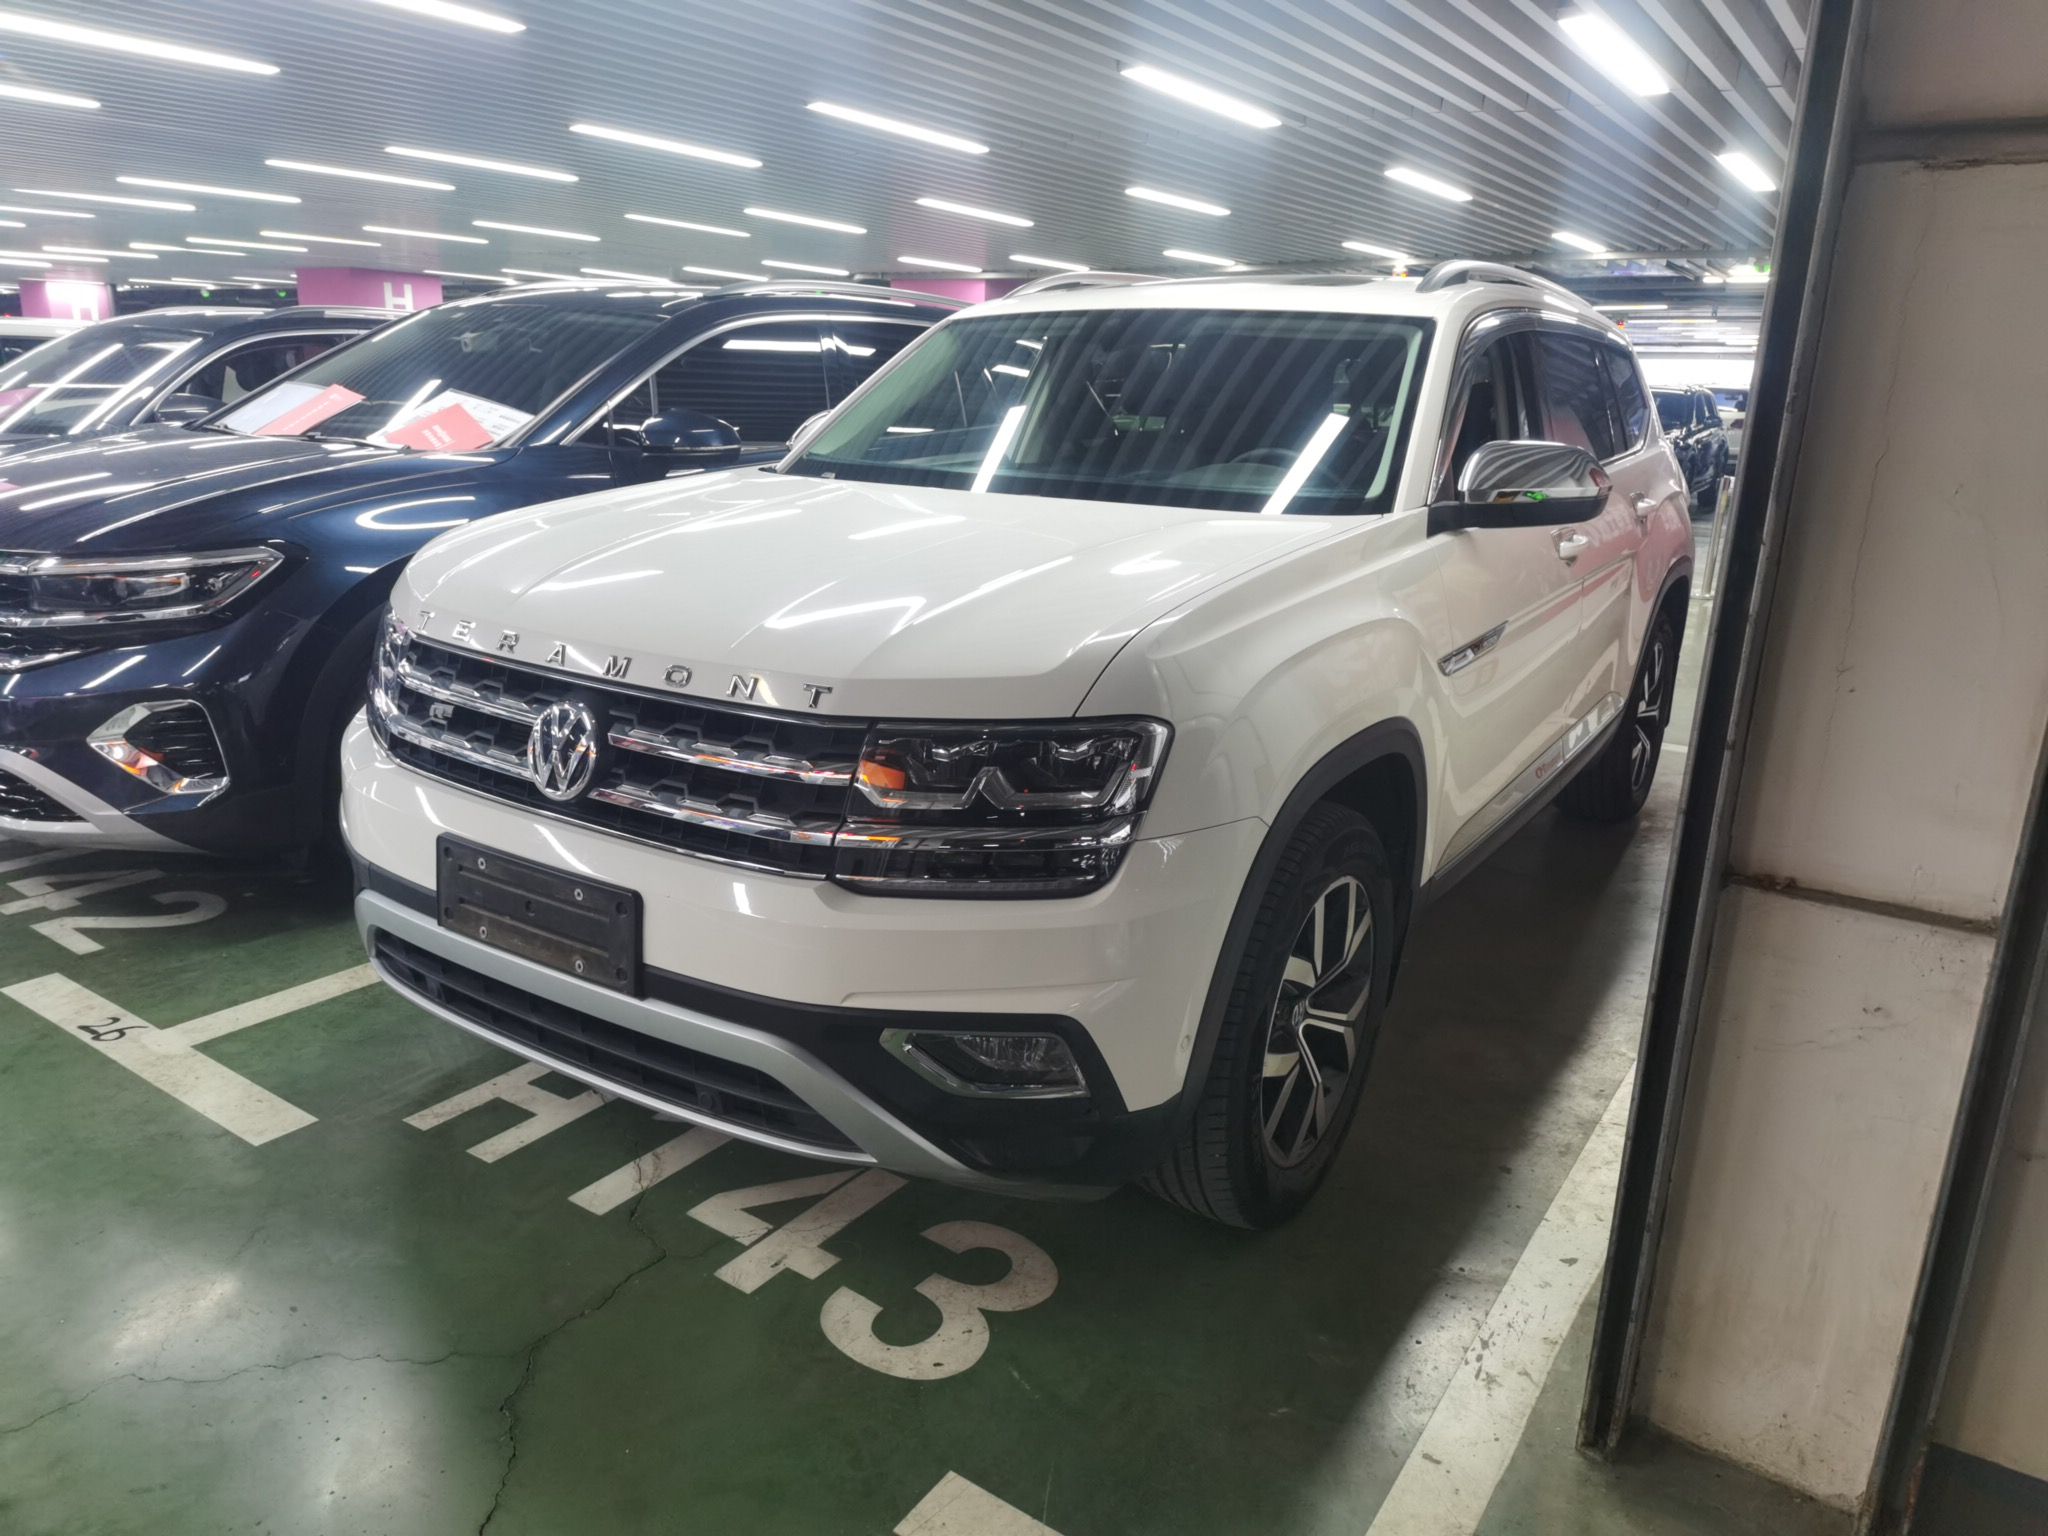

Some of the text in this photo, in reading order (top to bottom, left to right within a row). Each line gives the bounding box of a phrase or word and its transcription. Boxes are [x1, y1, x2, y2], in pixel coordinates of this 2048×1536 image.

[383, 282, 415, 313] H
[417, 610, 833, 709] TERAMONT
[77, 1016, 149, 1042] 26
